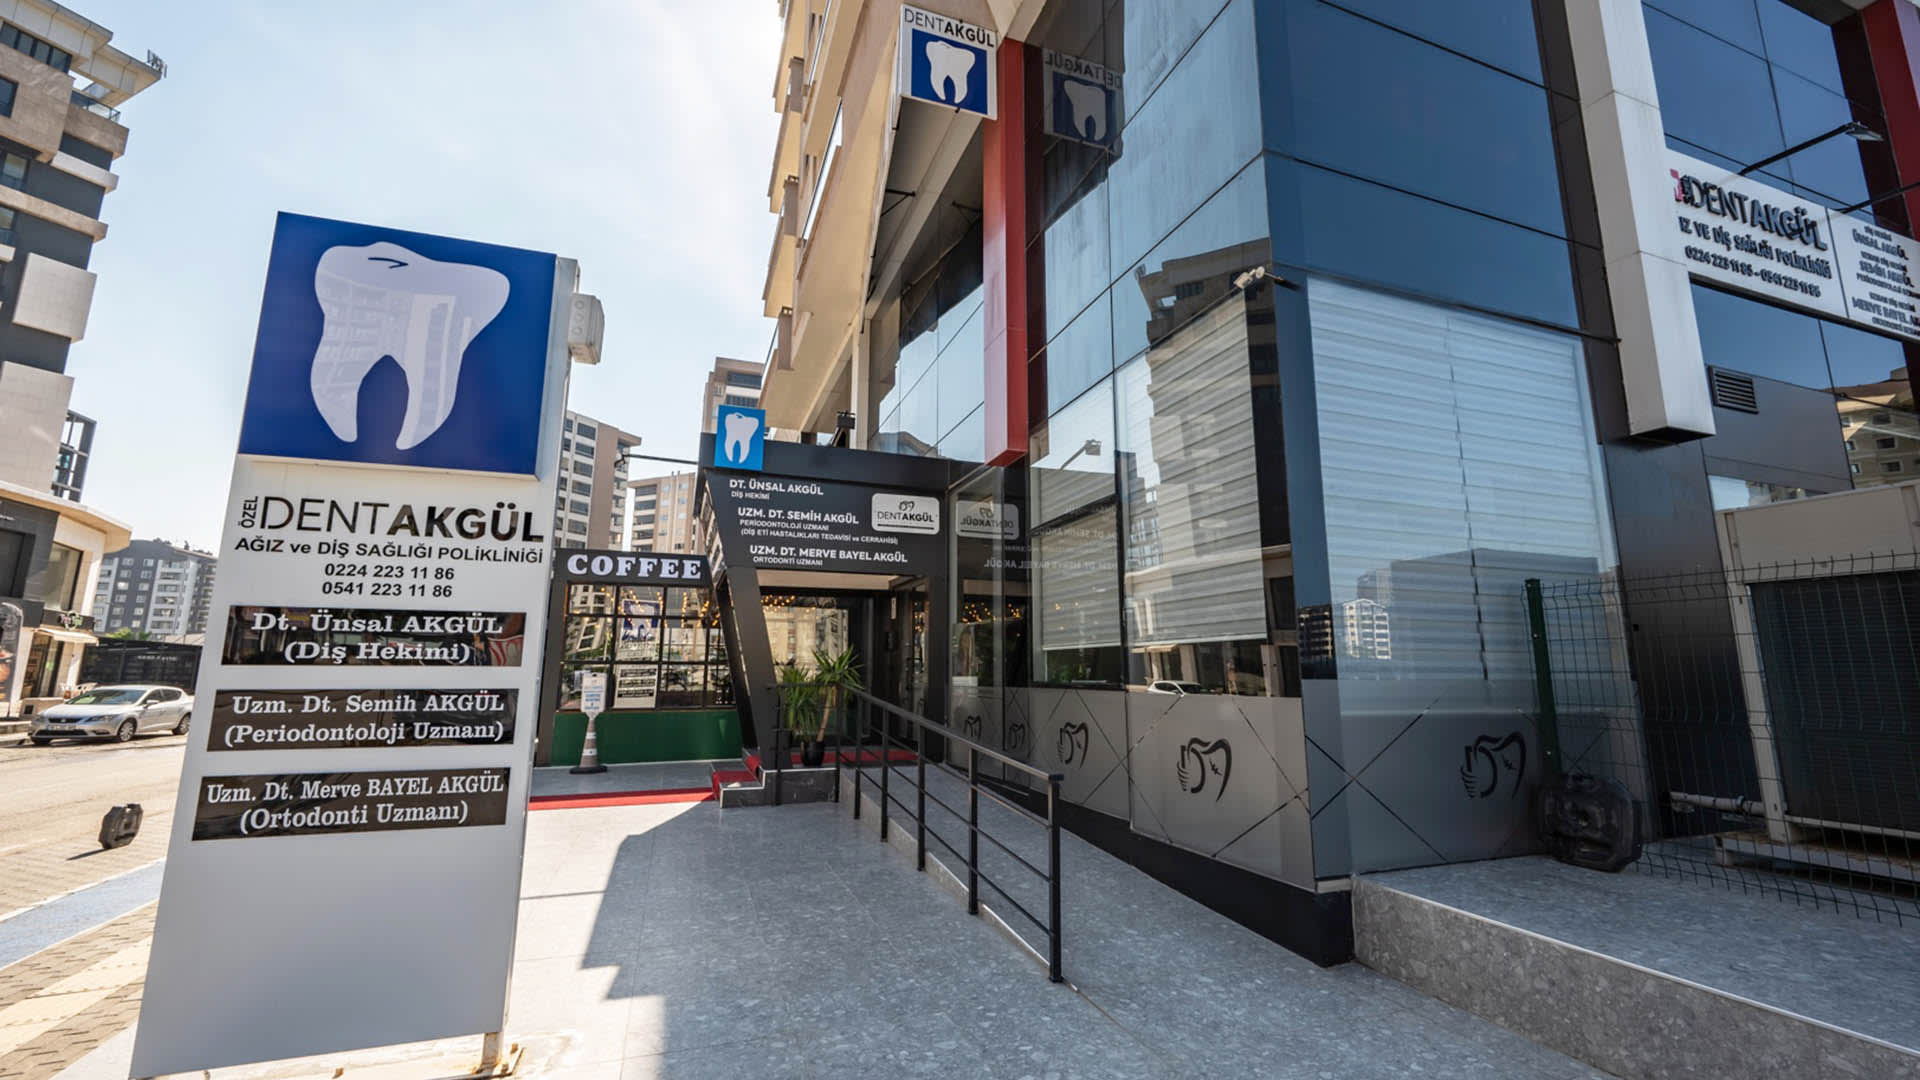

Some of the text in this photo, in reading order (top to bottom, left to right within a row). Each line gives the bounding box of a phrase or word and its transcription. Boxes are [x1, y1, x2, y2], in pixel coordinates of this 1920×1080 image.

[904, 8, 995, 48] DENTAKGÜL
[729, 478, 824, 495] DT. ÜNSAL AKGÜL
[731, 490, 770, 500] DİŞ HEKİMİ
[238, 496, 259, 529] ÖZEL
[260, 496, 544, 543] DENTAKGÜL
[738, 507, 859, 524] UZM. DT. SEMİH AKGÜL
[877, 511, 934, 523] DENTAKGÜL
[740, 519, 829, 531] PERİODONTOLOJİ UZMANI
[770, 531, 819, 539] HASTALIKLARI
[235, 537, 544, 563] AĞIZ ve DİŞ SAĞLIĞI POLİKLİNİĞİ
[750, 545, 908, 563] UZM. DT. MERVE BAYEL AKGÜL
[753, 556, 795, 565] ORTODONTİ
[325, 563, 455, 580] 0224 223 11 86
[567, 554, 701, 579] COFFEE
[322, 582, 453, 598] 0541 223 11 86
[251, 609, 502, 634] Dt. Ünsal AKGÜL
[284, 641, 470, 664] (Diş Hekimi)
[232, 690, 504, 714] Uzm. Dt. Semih AKGÜL
[224, 721, 503, 748] (Periodontoloji Uzmanı)
[207, 770, 504, 804] Uzm. Dt. Merve BAYEL AKGÜL
[240, 800, 469, 835] (Ortodonti Uzmanı)
